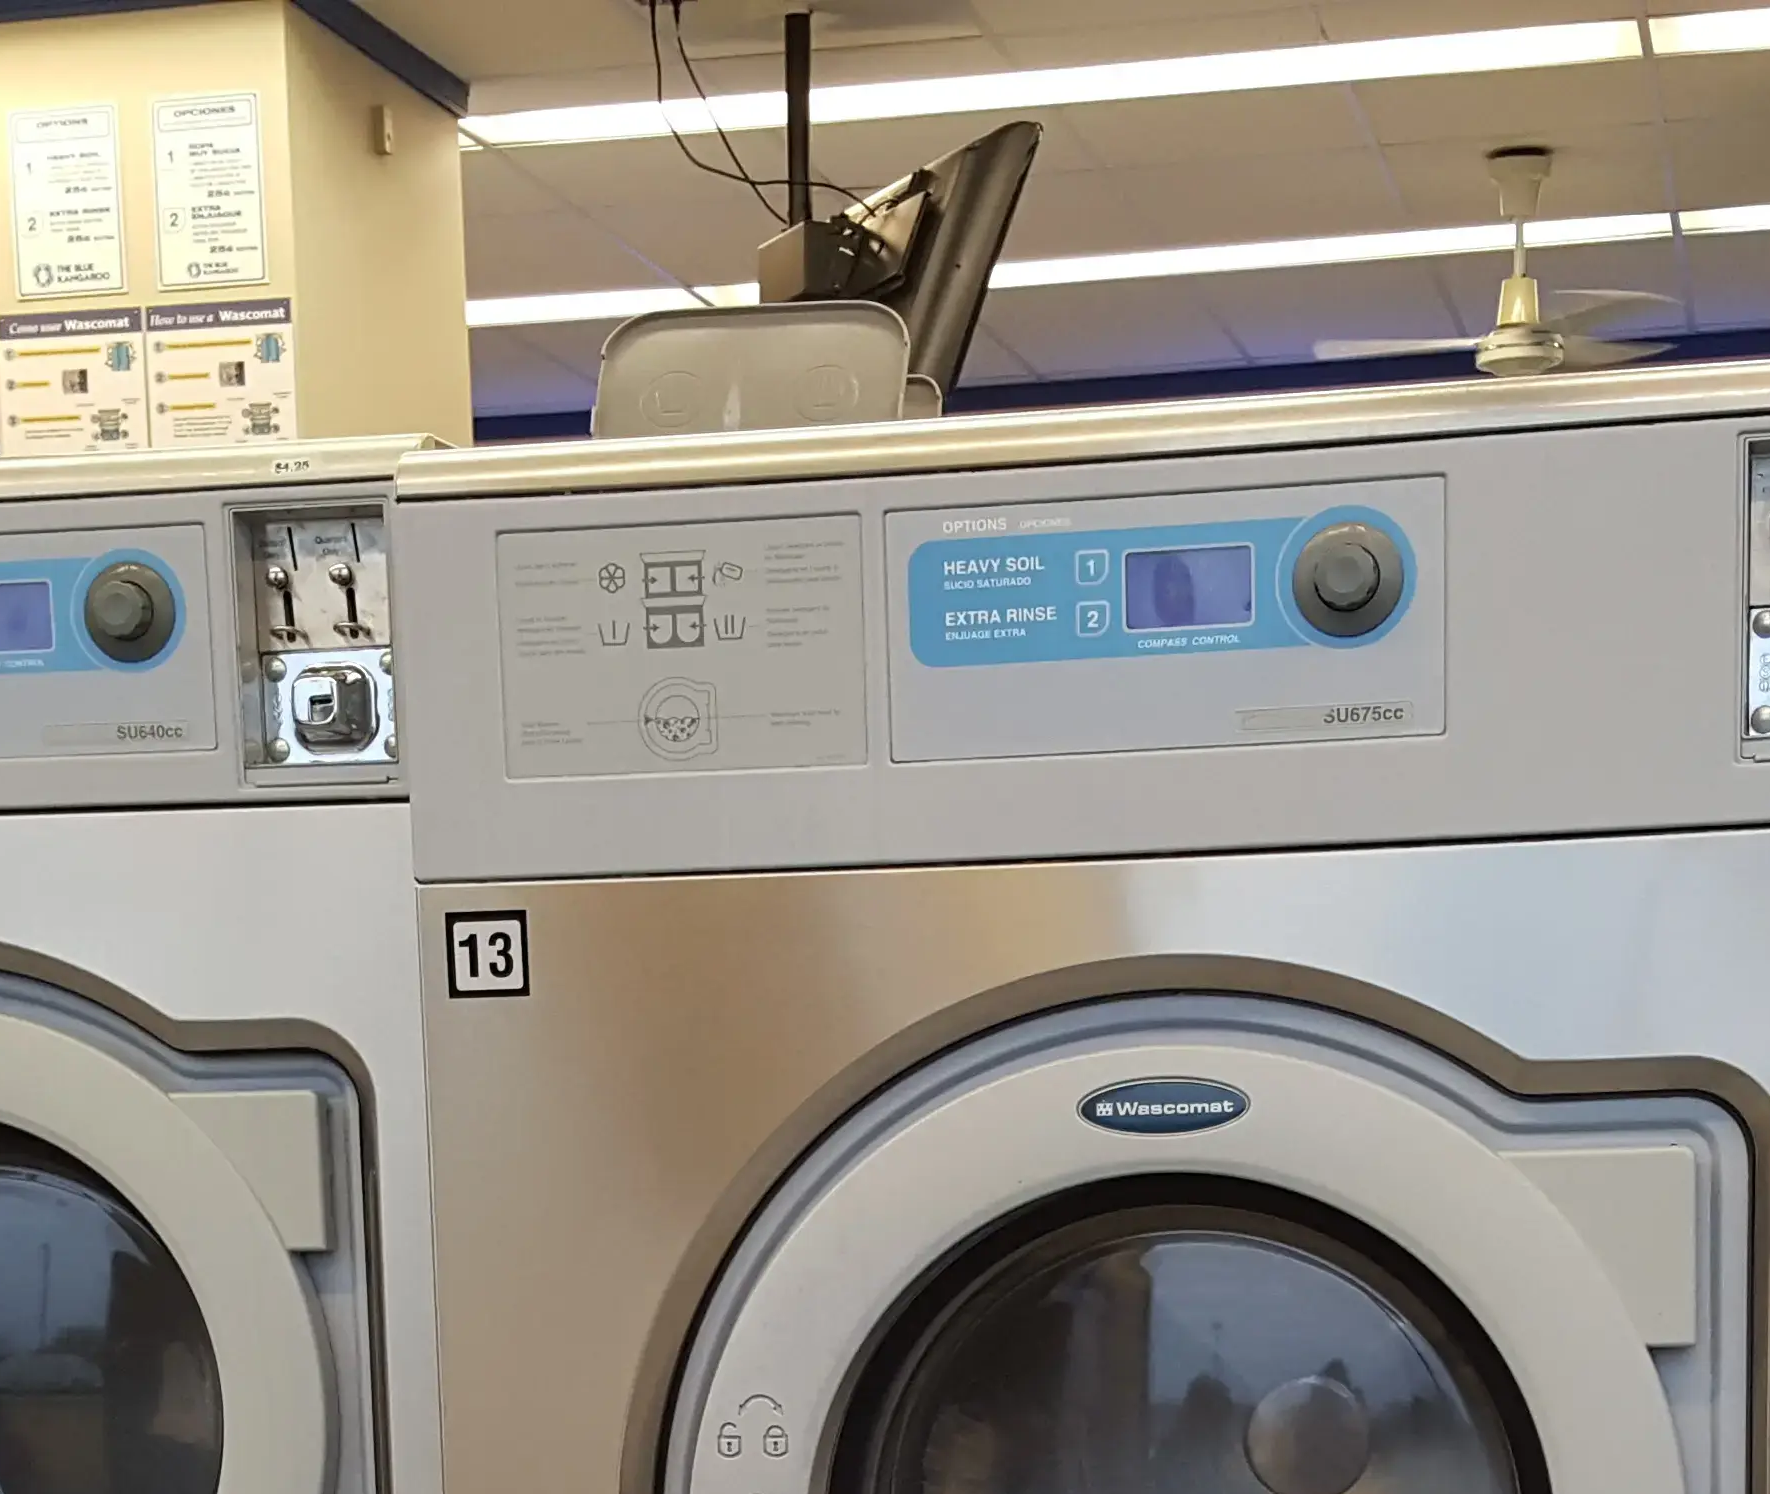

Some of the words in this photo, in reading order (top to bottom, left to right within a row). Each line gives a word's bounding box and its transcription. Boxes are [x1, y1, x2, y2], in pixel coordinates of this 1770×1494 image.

[28, 217, 37, 232] 2
[169, 212, 179, 227] 2
[63, 316, 130, 331] Wascomat
[150, 314, 175, 326] How
[176, 314, 187, 324] to
[188, 315, 206, 323] use
[218, 307, 285, 322] Wascomat
[942, 518, 1007, 534] OPTIONS
[943, 558, 999, 576] HEAVY
[1005, 557, 1044, 572] SOIL
[1086, 560, 1096, 577] 1
[943, 580, 974, 591] SUCIO
[976, 576, 1031, 588] SATURADO
[945, 609, 1001, 627] EXTRA
[1006, 606, 1057, 622] RINSE
[1087, 611, 1099, 628] 2
[945, 630, 991, 641] ENJUAGE
[994, 628, 1026, 638] EXTRA
[1137, 637, 1187, 649] COMPASS
[1192, 635, 1241, 646] CONTROL
[1323, 706, 1404, 724] SU675cc
[116, 724, 183, 740] SU640cc
[457, 930, 515, 979] 13
[1116, 1098, 1234, 1117] Wascomat
